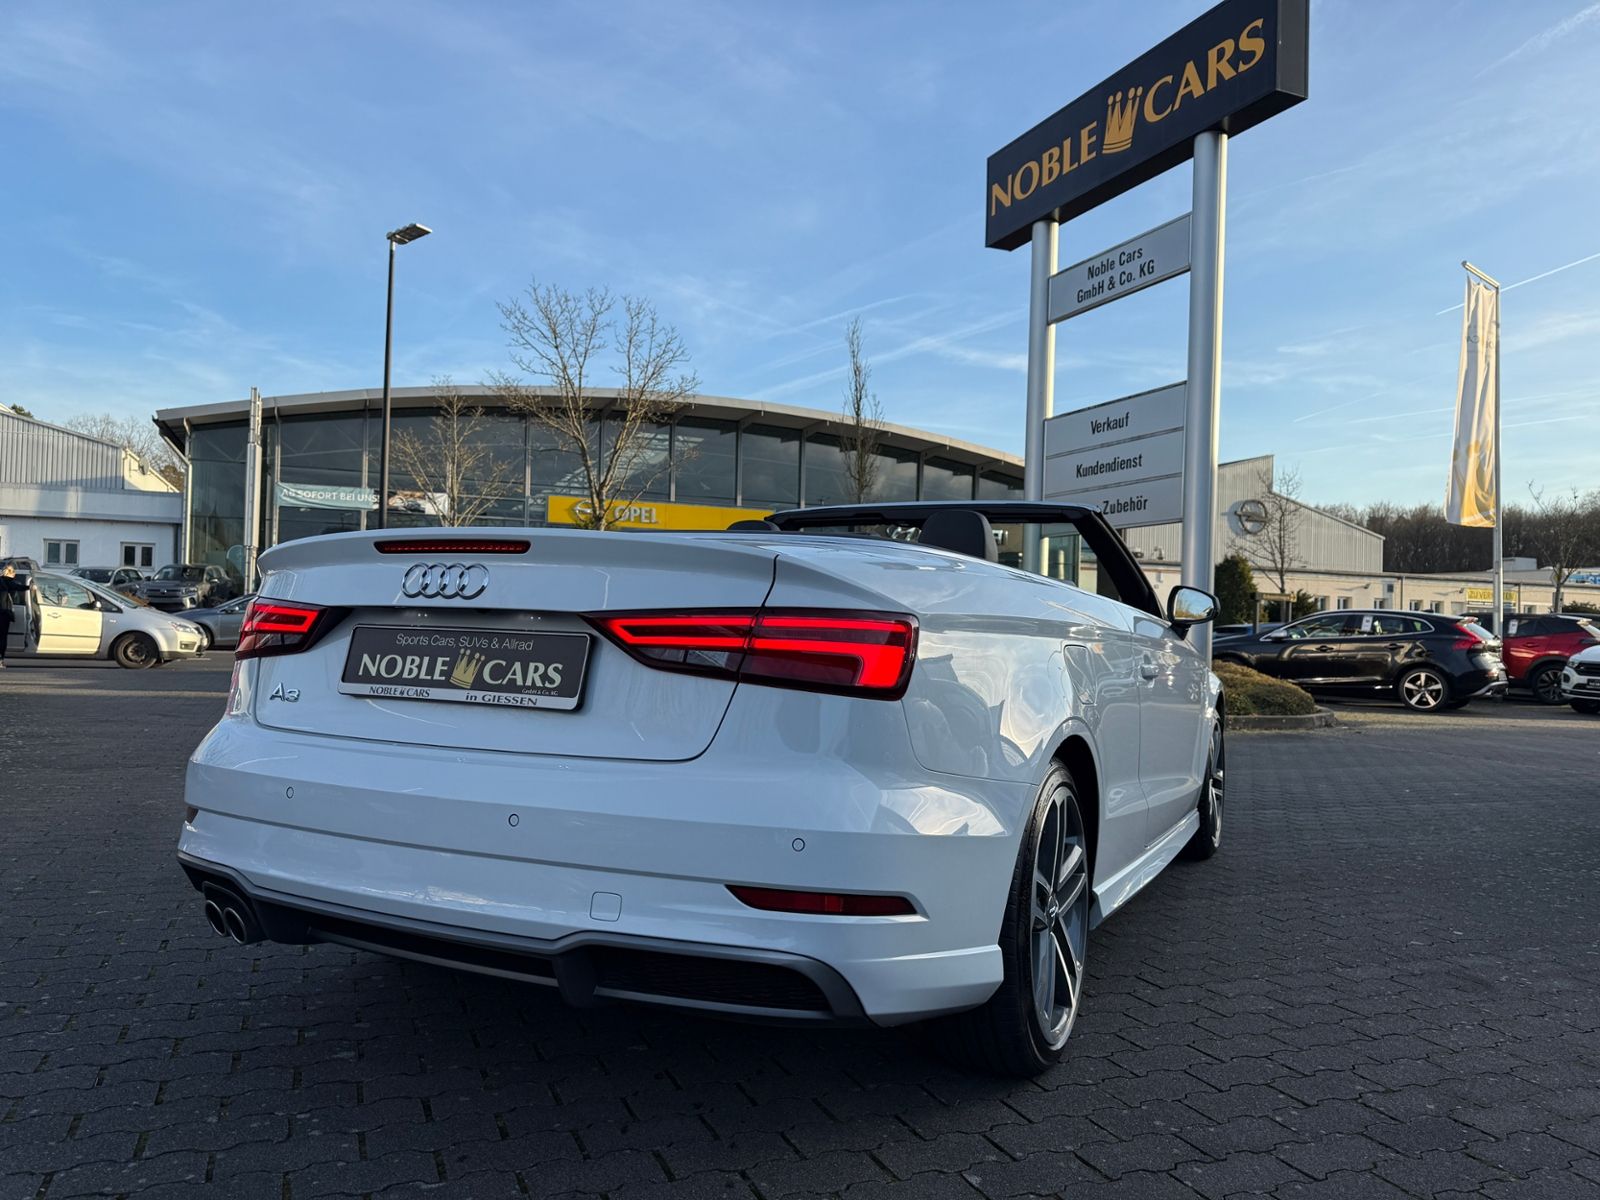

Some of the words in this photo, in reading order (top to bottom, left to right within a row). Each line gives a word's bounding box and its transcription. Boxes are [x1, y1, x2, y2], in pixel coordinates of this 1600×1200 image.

[991, 121, 1097, 216] NOBLE
[1143, 18, 1265, 123] CARS
[1087, 258, 1115, 280] Noble
[1118, 248, 1143, 266] Cars
[1077, 283, 1104, 303] GmbH
[1108, 275, 1116, 291] &
[1119, 271, 1136, 286] Co.
[1139, 259, 1155, 279] KG
[1090, 411, 1130, 435] Verkauf
[1076, 454, 1143, 479] Kundendienst
[297, 489, 337, 501] SOFORT
[340, 492, 355, 501] BEI
[614, 505, 657, 523] OPEL
[1103, 496, 1148, 515] Zubehör
[396, 633, 429, 647] Sports
[431, 634, 456, 648] Cars,
[459, 635, 488, 648] SUVs
[491, 637, 499, 649] &
[502, 638, 534, 651] Allrad
[358, 653, 450, 681] NOBLE
[482, 659, 563, 688] CARS
[269, 682, 300, 702] A3
[369, 686, 399, 696] NOBLE
[406, 688, 430, 698] CARS
[465, 692, 477, 701] in
[481, 693, 538, 706] GIESSEN
